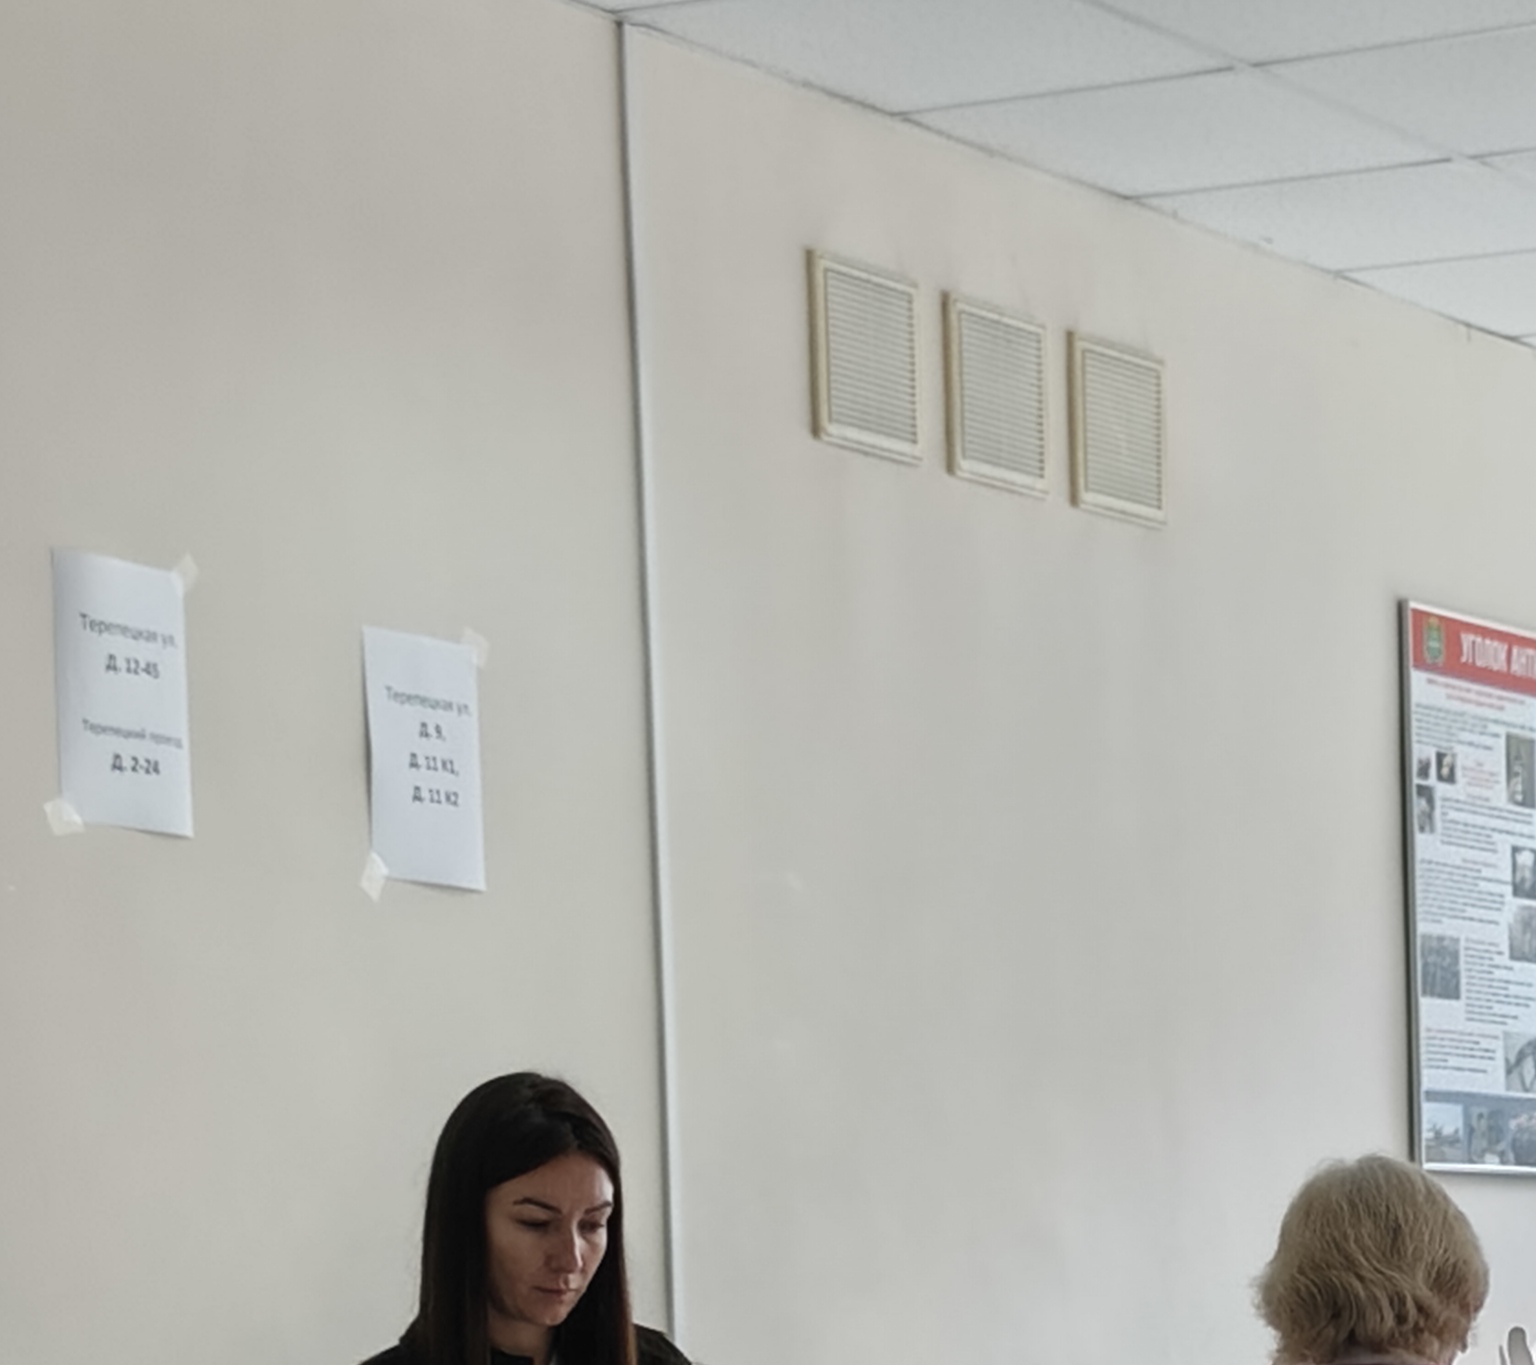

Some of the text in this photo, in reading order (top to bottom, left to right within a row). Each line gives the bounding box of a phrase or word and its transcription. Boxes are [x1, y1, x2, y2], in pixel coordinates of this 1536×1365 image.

[79, 611, 179, 650] Терепецкая ул.
[1460, 631, 1509, 674] УГОЛОК
[105, 653, 160, 680] Д. 12-45
[456, 703, 473, 717] ул.
[419, 722, 433, 740] Д.
[111, 753, 161, 776] Д. 2-24
[409, 752, 422, 770] Д.
[424, 756, 439, 772] 11
[412, 785, 426, 803] Д.
[428, 789, 442, 805] 11
